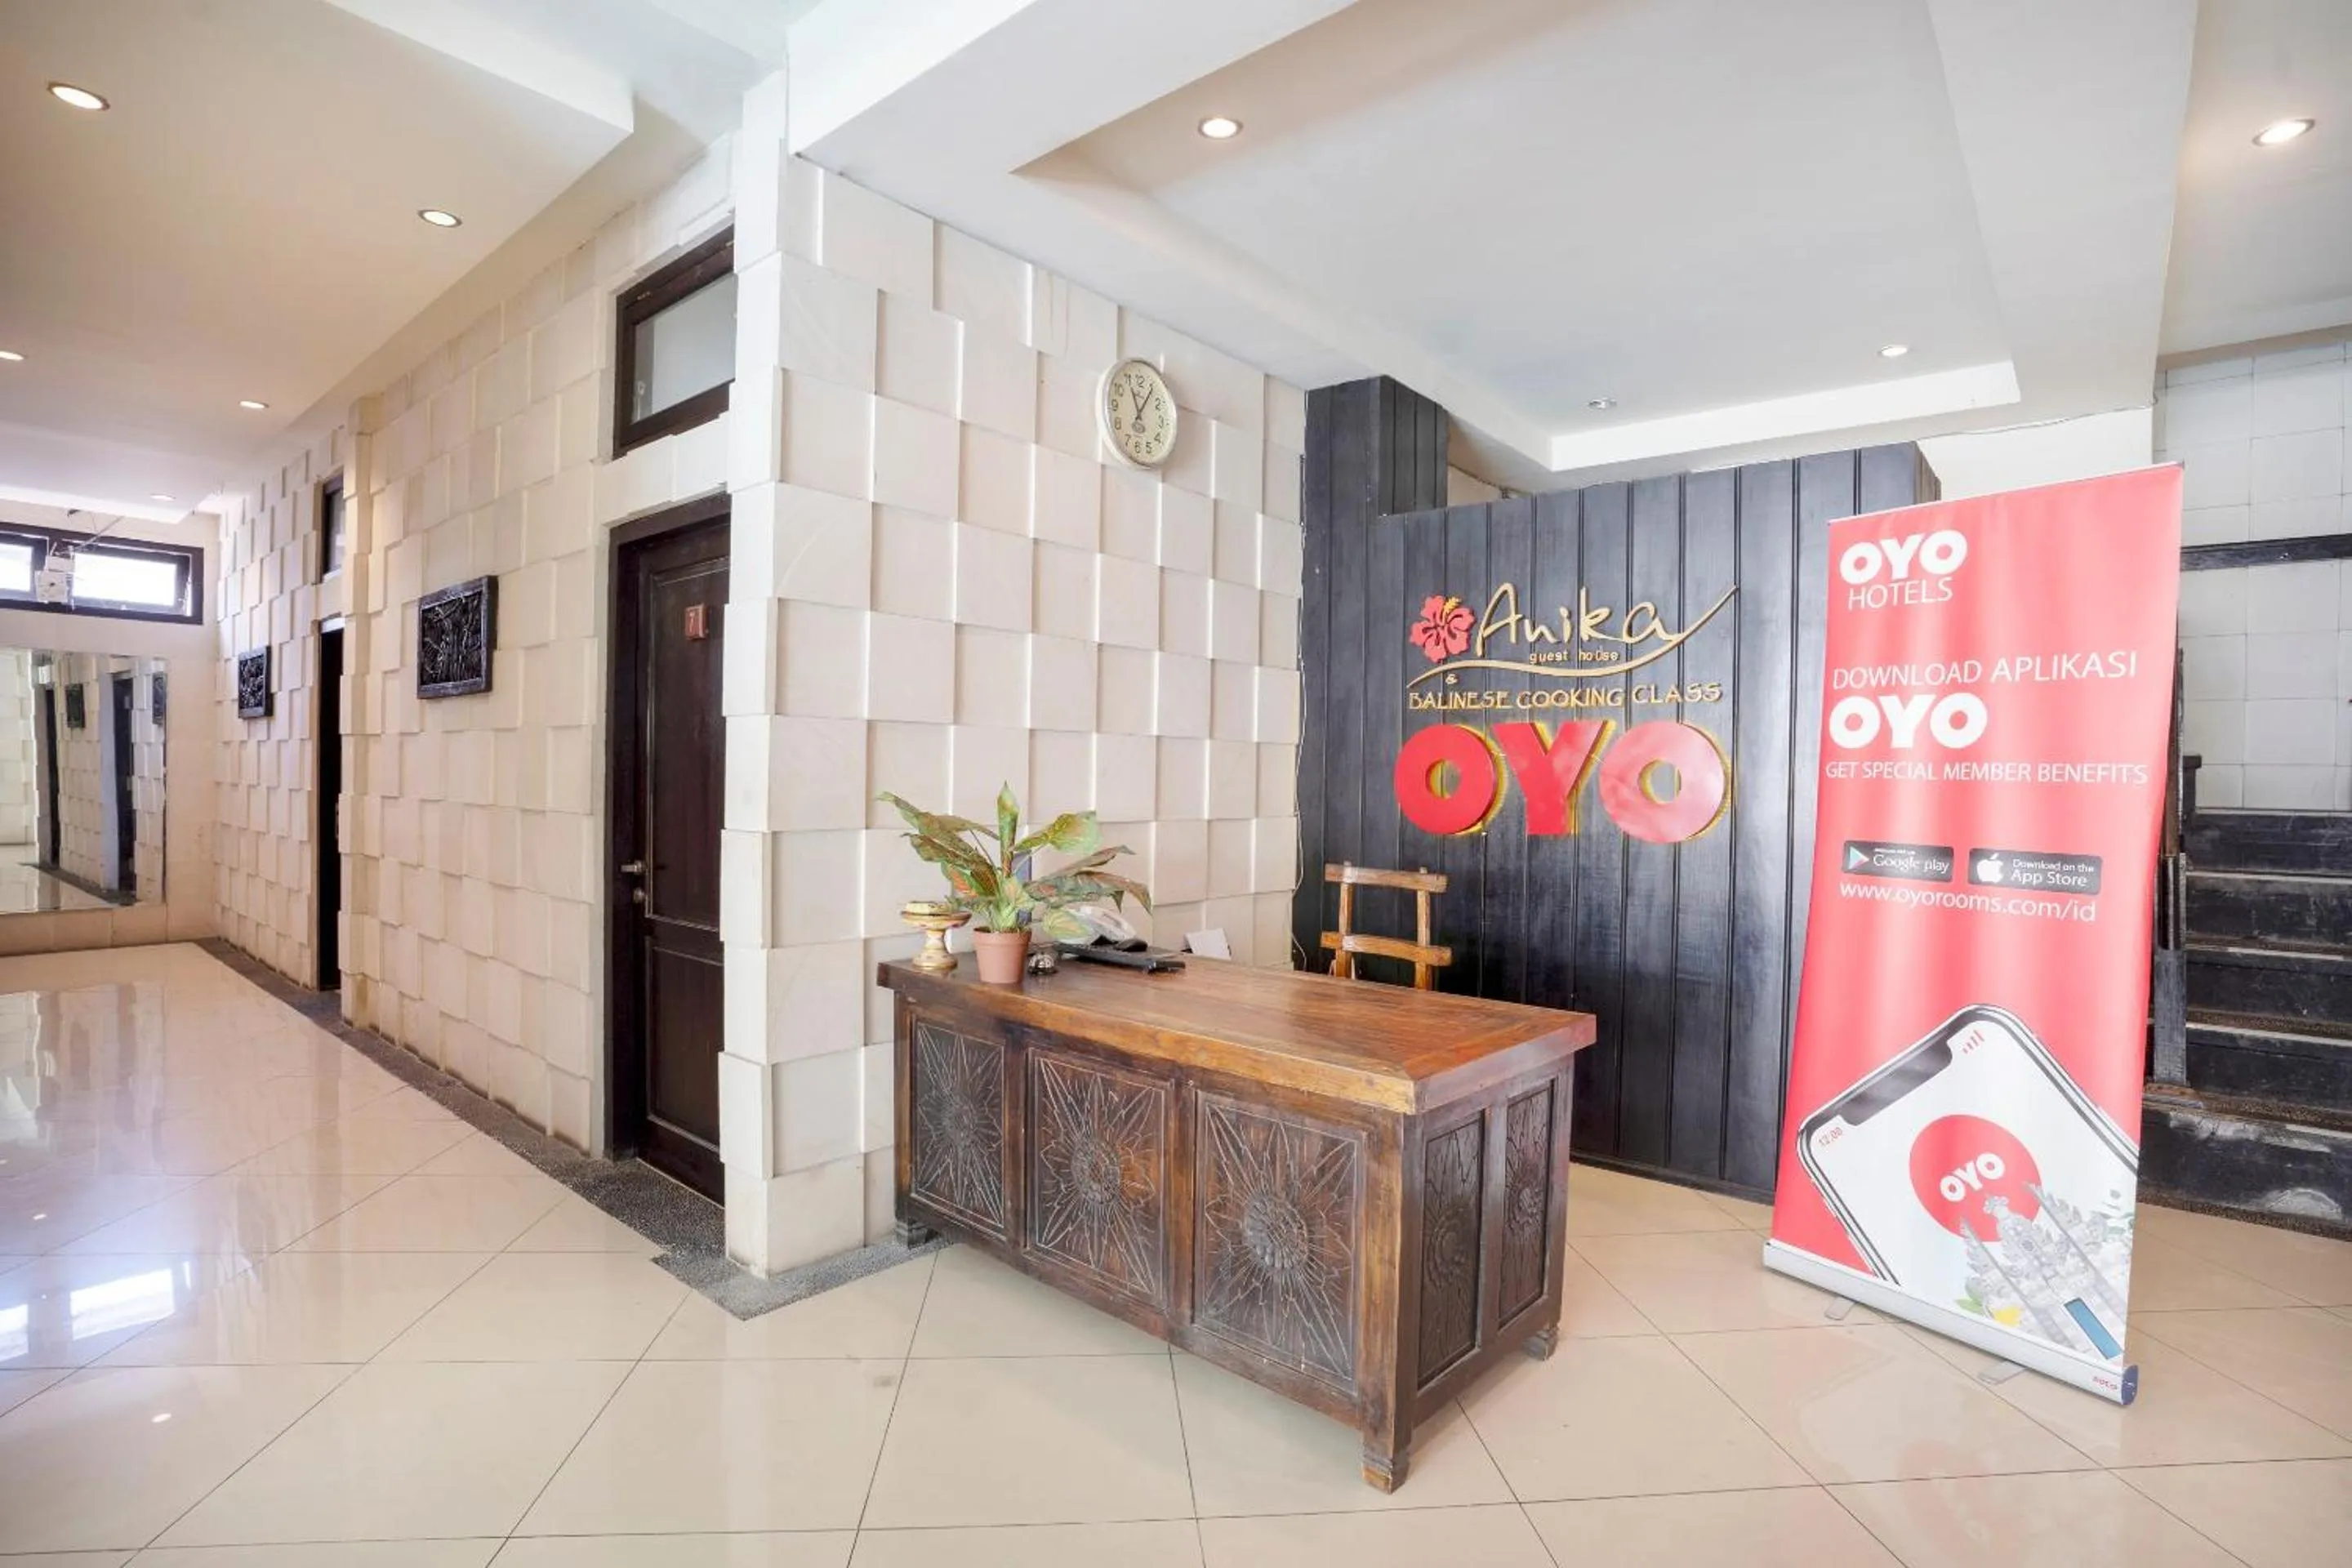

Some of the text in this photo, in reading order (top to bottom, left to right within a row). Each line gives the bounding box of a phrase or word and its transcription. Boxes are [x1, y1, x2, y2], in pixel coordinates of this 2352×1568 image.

[1839, 529, 1968, 585] OYO
[1847, 577, 1953, 611] HOTELS
[1476, 582, 1690, 657] Anika
[1529, 649, 1619, 665] guest house
[1833, 651, 2138, 690] DOWNLOAD APLIKASI
[1408, 682, 1722, 710] BALINESE COOKING CLASS
[1829, 692, 1988, 750] OYO
[1393, 719, 1731, 844] OYO
[1825, 761, 2149, 786] GET SPECIAL MEMBER BENEFITS
[1873, 853, 1950, 874] Google play
[2011, 869, 2088, 887] App Store
[2012, 858, 2095, 873] Download on the
[1840, 881, 2096, 923] www.oyorooms.com/id
[1940, 1152, 2007, 1203] OYO
